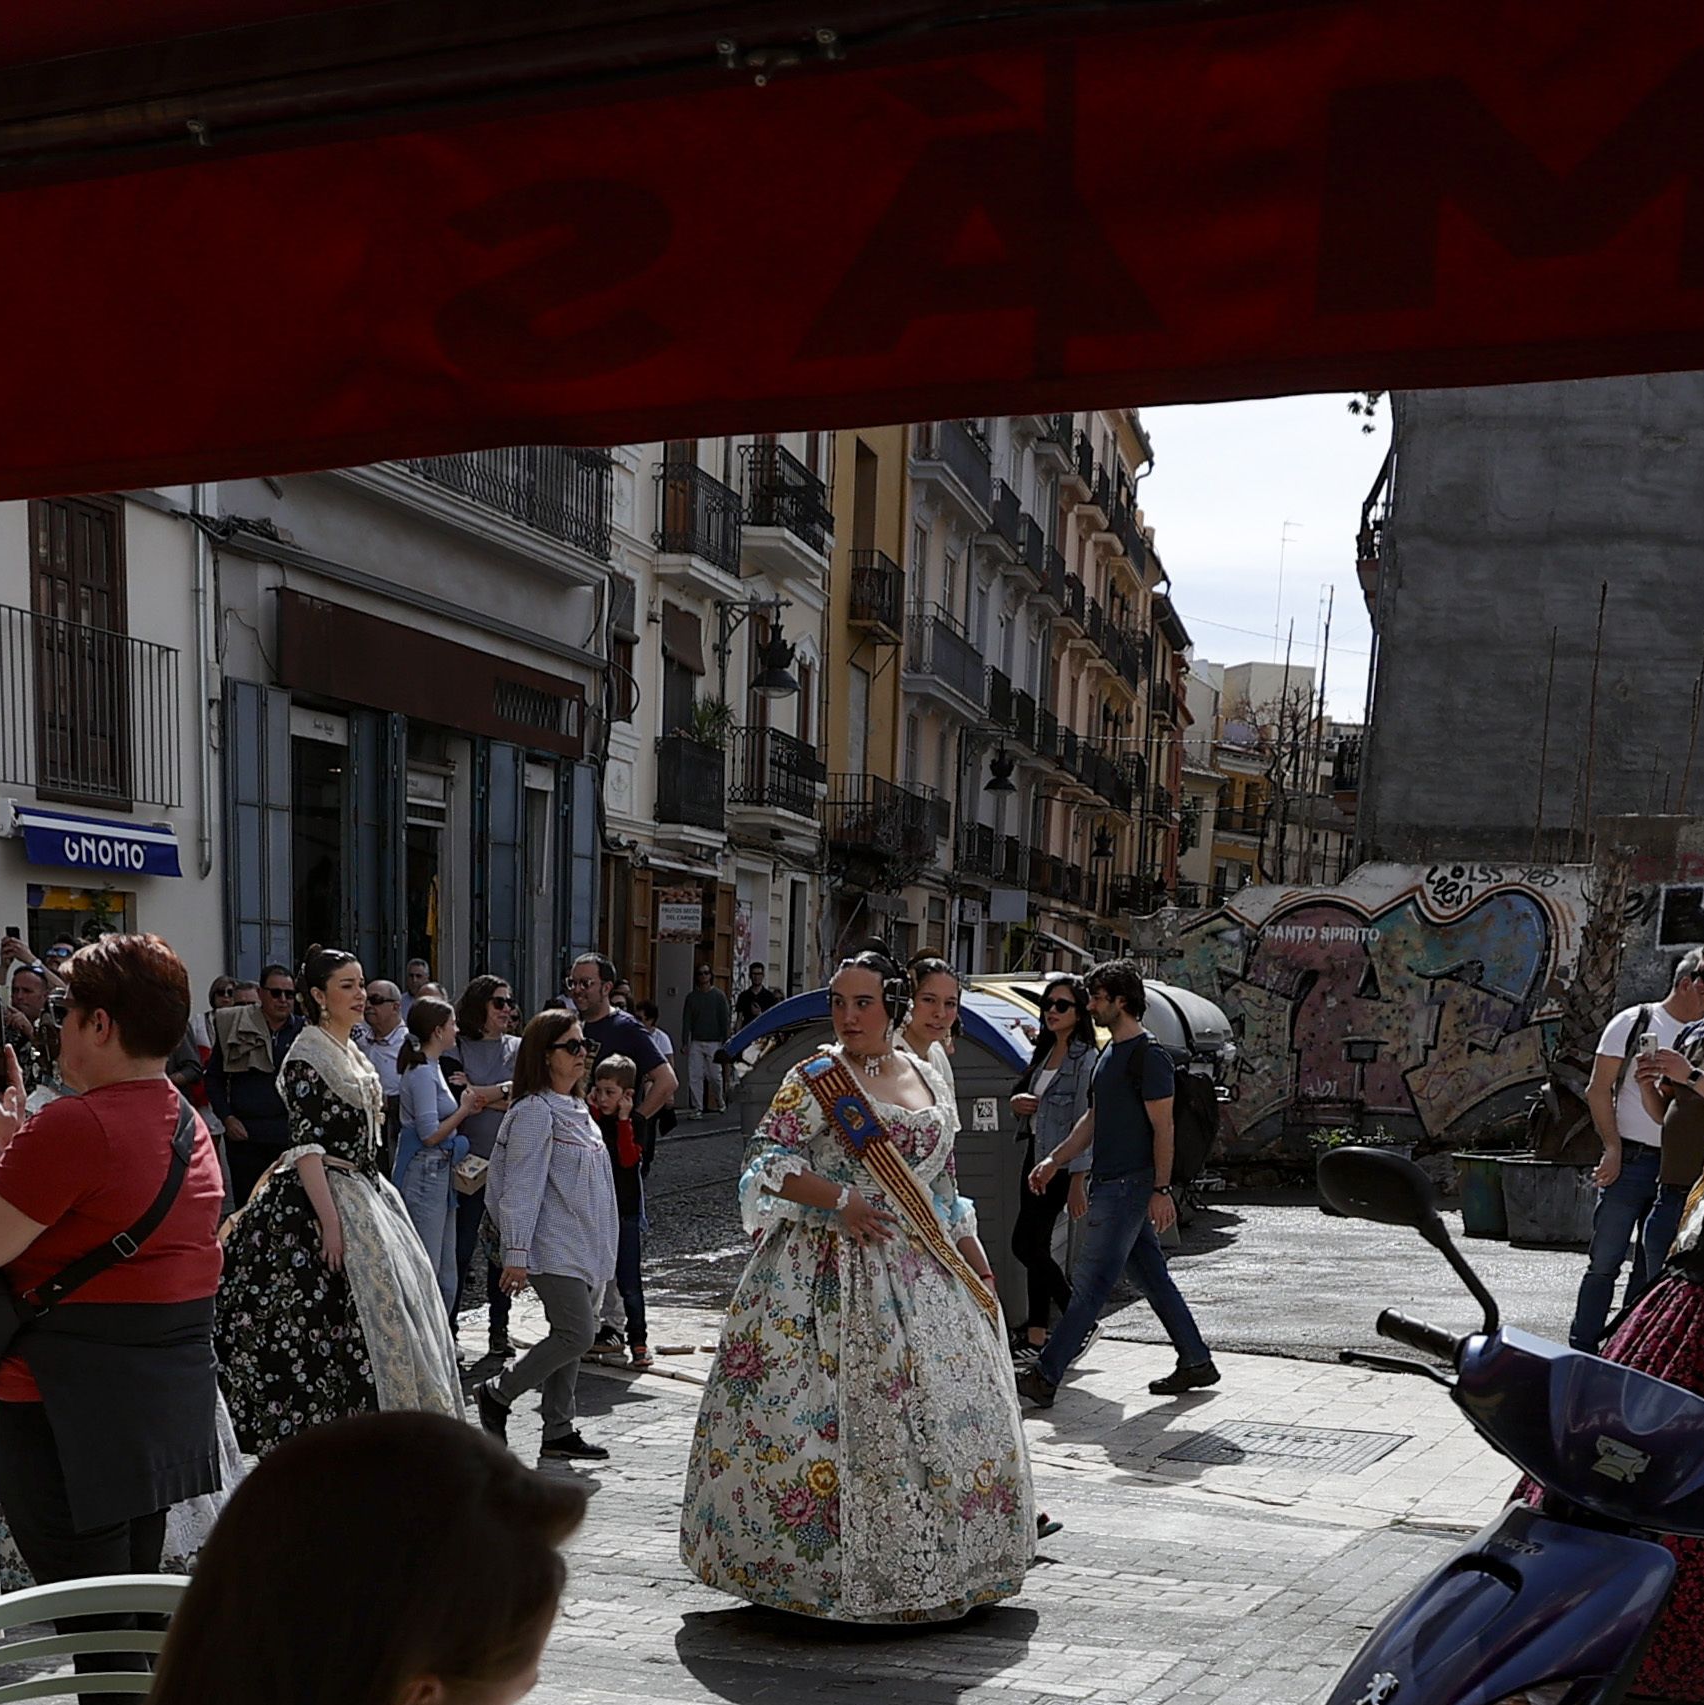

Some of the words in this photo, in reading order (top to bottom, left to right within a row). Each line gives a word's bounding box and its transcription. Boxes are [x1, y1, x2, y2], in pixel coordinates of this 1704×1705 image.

[64, 836, 145, 870] GNOMO
[1263, 924, 1316, 946] SANTO
[1319, 925, 1381, 946] SPIRITO
